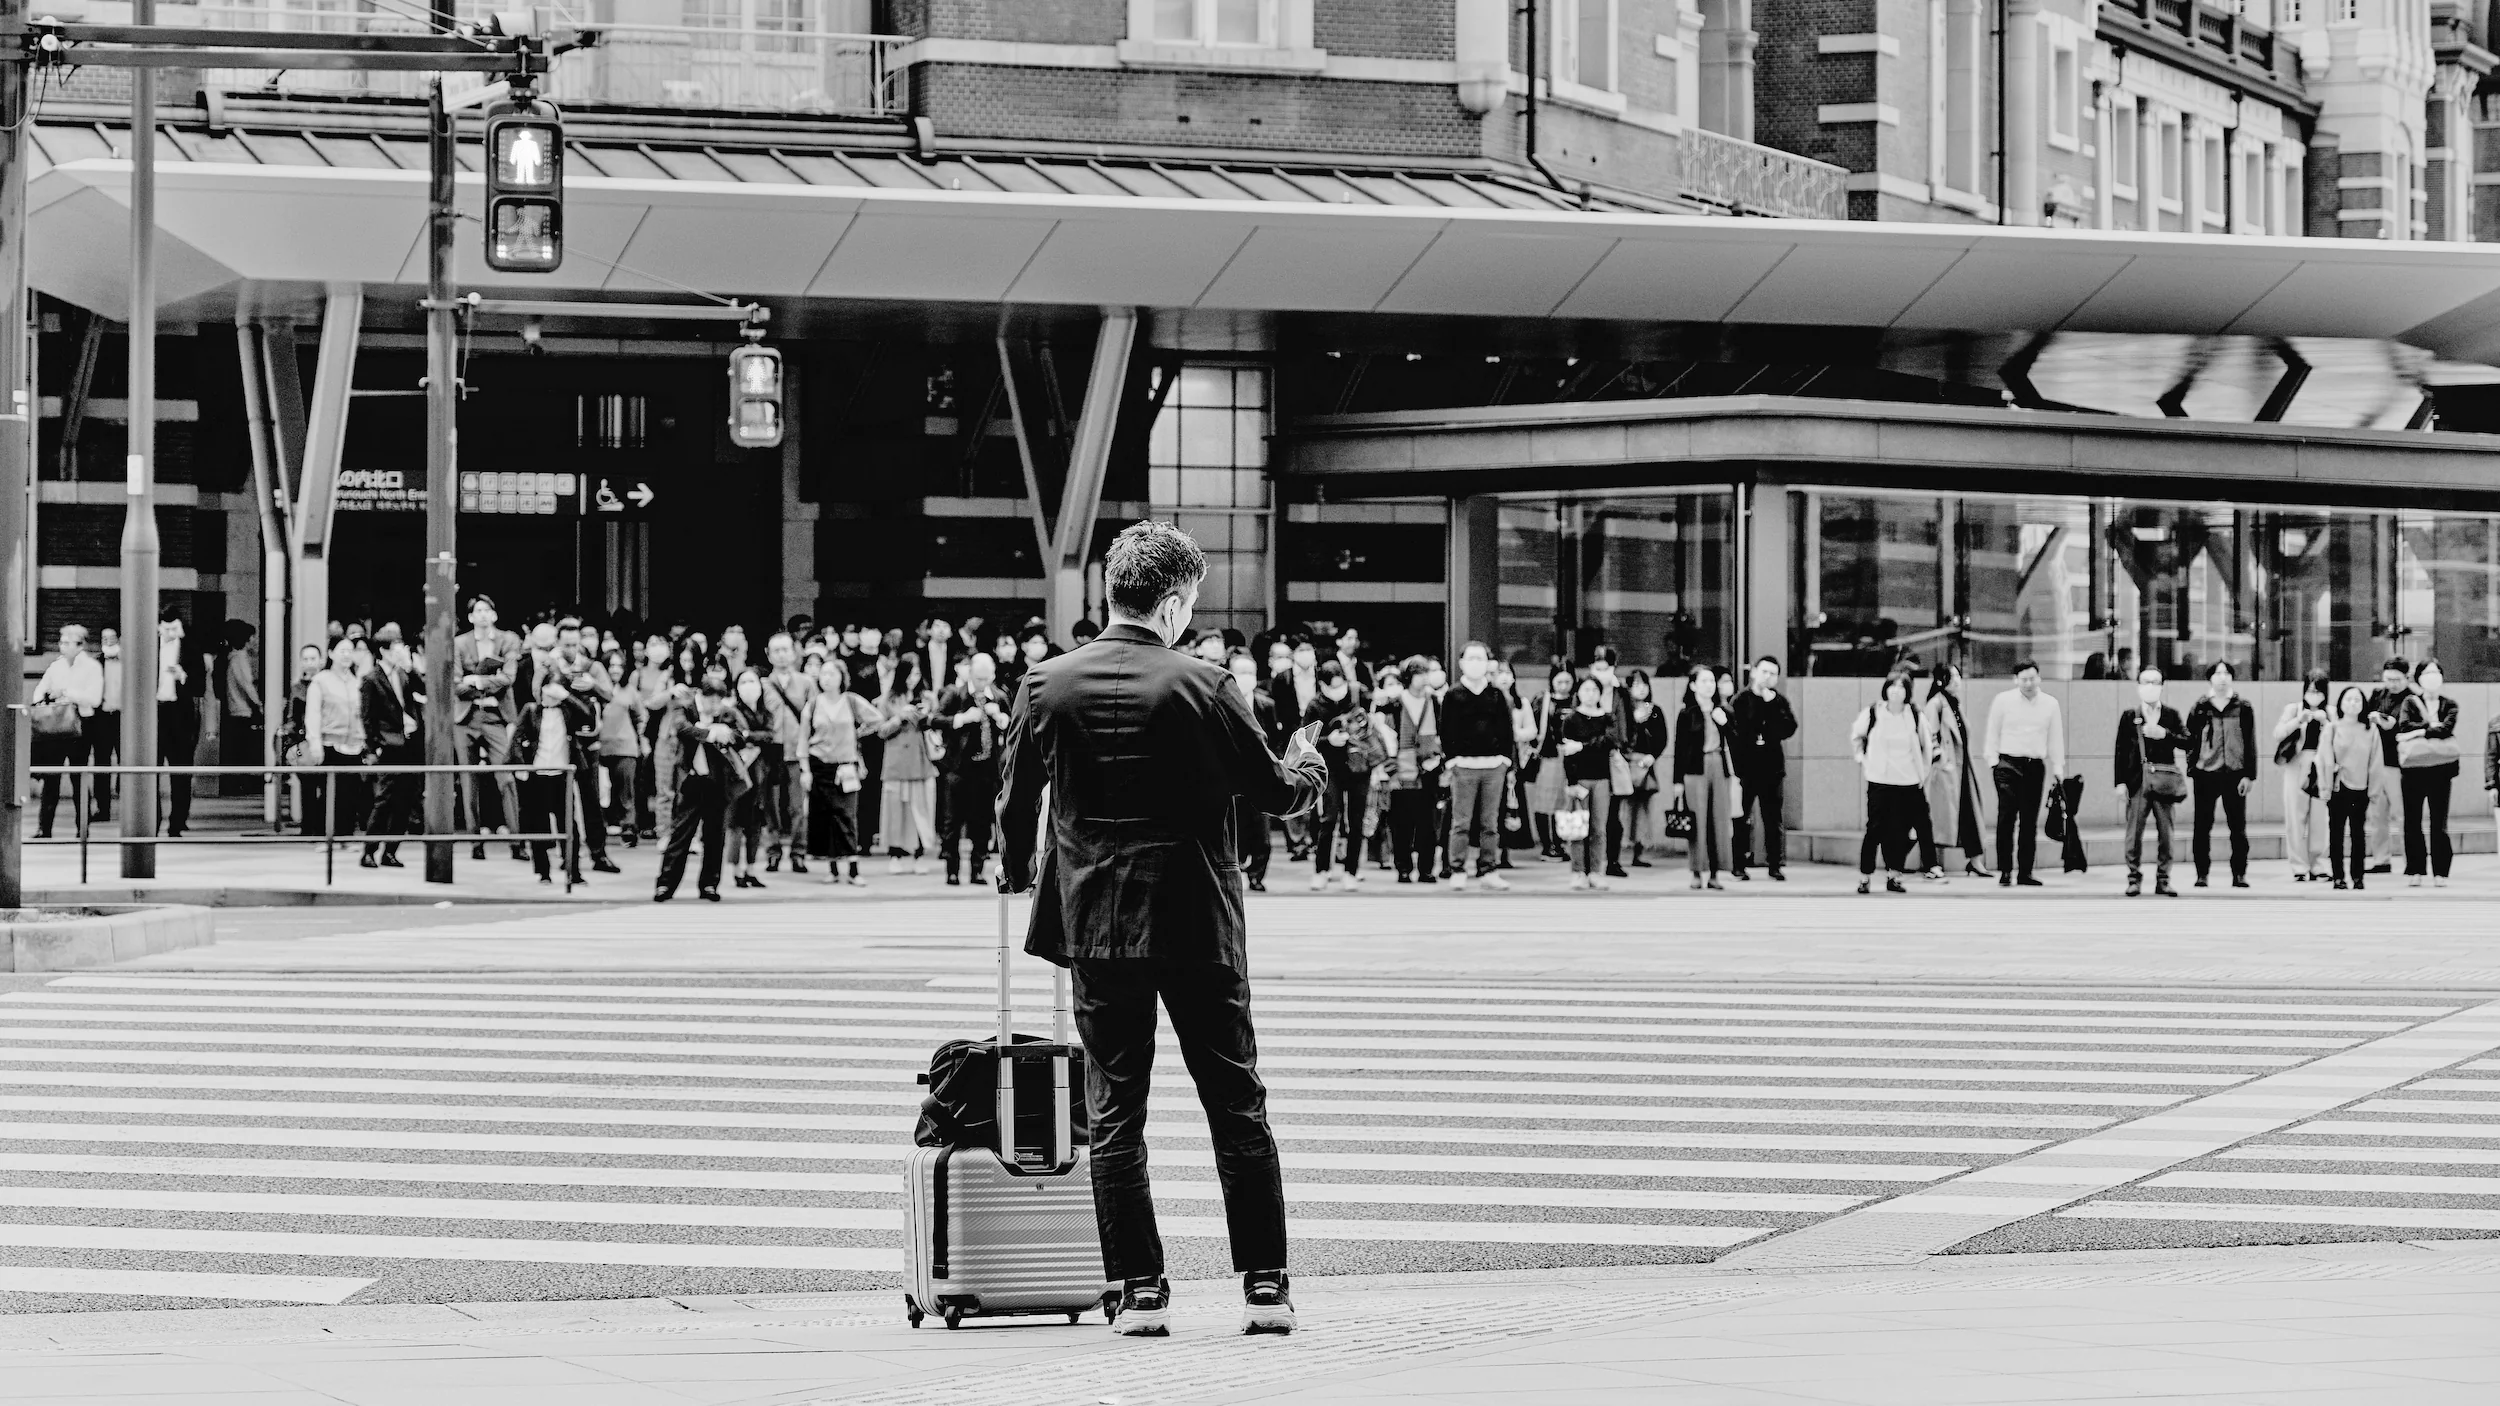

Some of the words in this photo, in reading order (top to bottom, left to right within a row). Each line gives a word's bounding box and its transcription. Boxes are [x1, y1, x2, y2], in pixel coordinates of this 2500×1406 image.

[336, 469, 403, 489] の内北口
[380, 489, 406, 500] North
